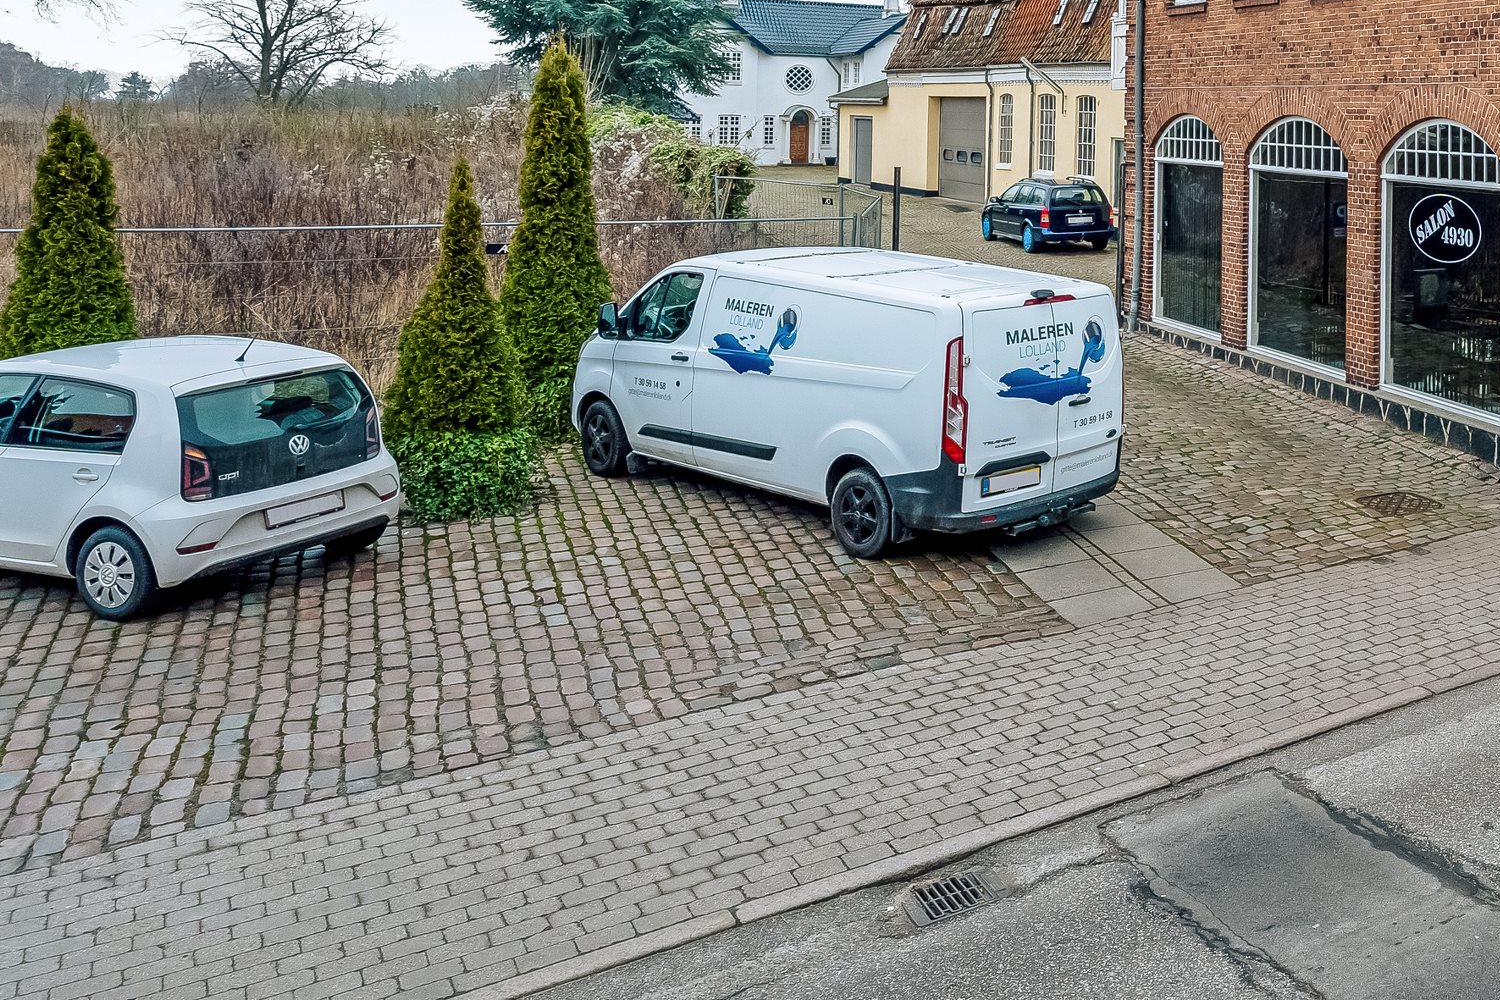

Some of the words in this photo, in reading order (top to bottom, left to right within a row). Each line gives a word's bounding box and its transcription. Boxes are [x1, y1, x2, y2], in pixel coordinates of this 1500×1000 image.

[1416, 199, 1455, 245] SALON
[1441, 226, 1474, 248] 4930
[724, 297, 775, 318] MALEREN
[729, 314, 764, 330] LOLLAND
[1005, 321, 1074, 345] MALEREN
[1019, 340, 1066, 359] LOLLAND
[638, 378, 645, 387] 30
[645, 379, 652, 388] 59
[653, 381, 659, 389] 14
[659, 382, 667, 391] 58
[1073, 420, 1078, 428] T
[1079, 418, 1087, 427] 30
[1089, 415, 1097, 425] 59
[1098, 413, 1105, 422] 14
[1106, 410, 1113, 419] 58
